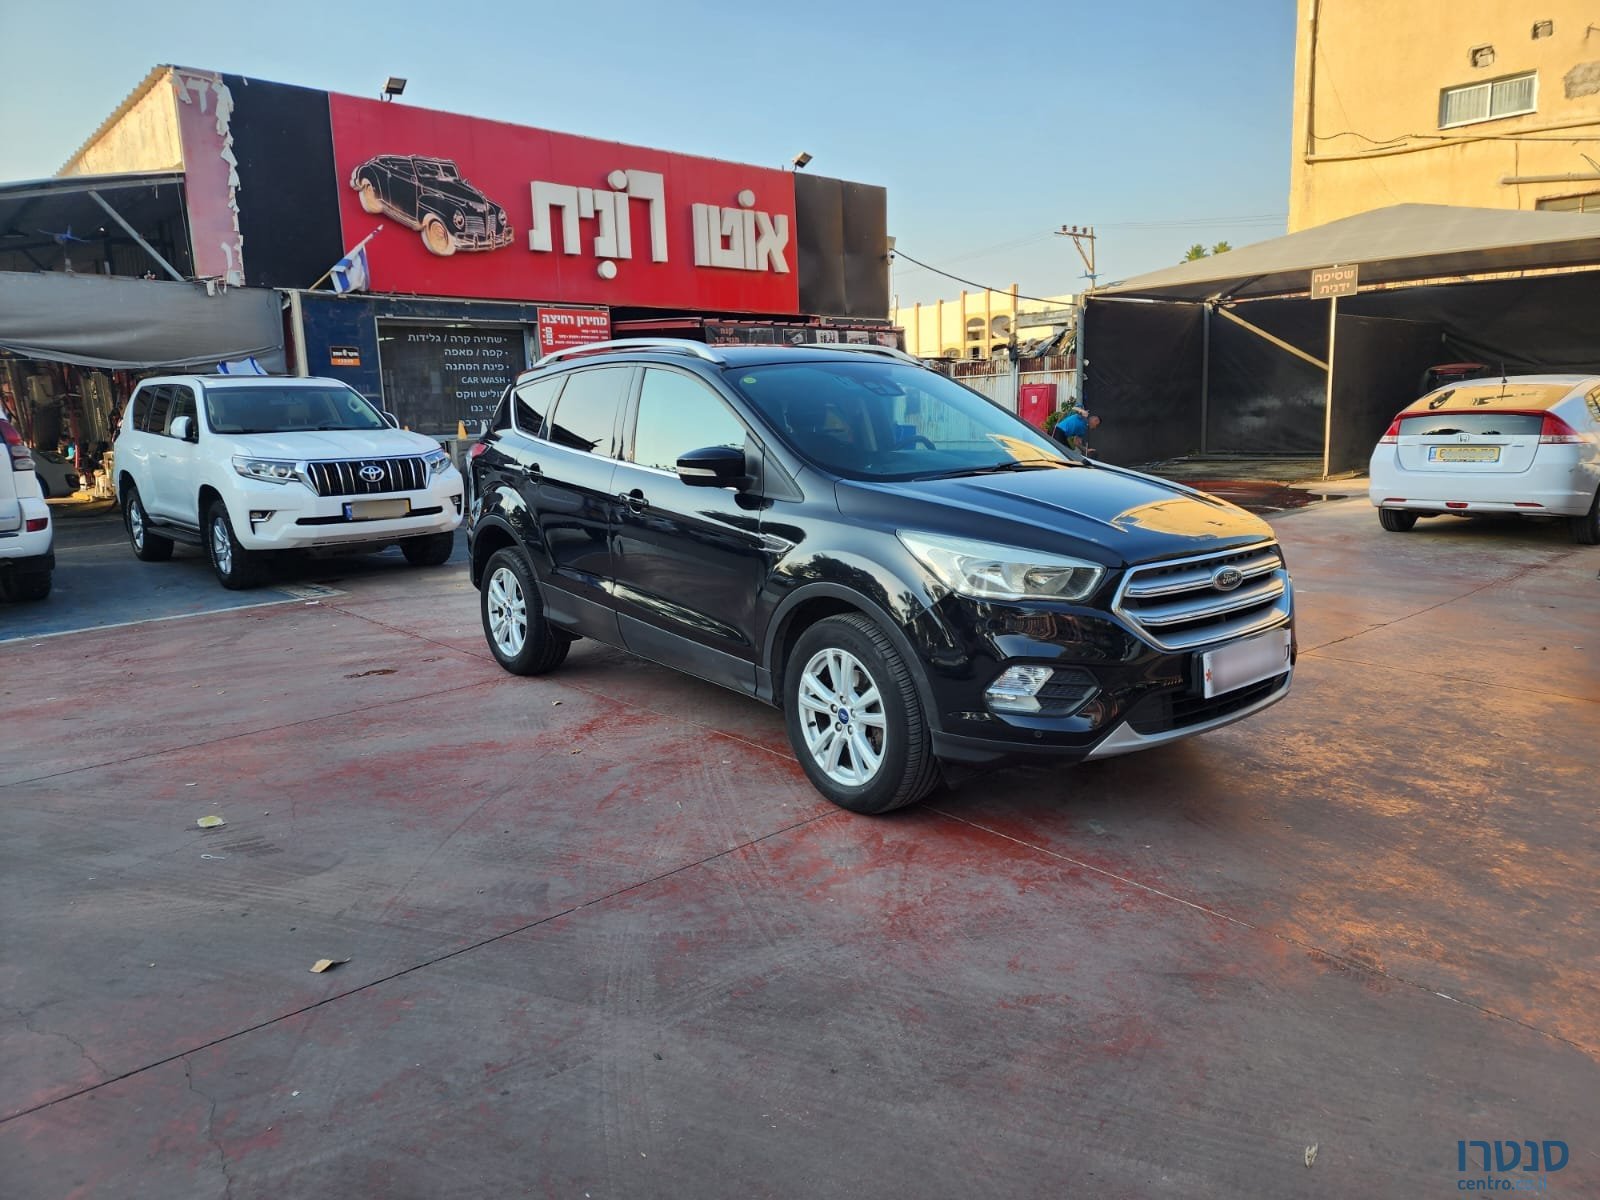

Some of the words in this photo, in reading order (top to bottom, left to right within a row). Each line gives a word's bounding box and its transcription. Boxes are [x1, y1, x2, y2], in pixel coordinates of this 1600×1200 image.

[541, 313, 575, 324] רחיצה
[576, 315, 608, 327] מחירון
[407, 333, 441, 343] גלידות
[450, 335, 471, 345] קרה
[474, 335, 503, 344] שתייה
[444, 348, 474, 357] מאפה
[482, 349, 503, 359] קפה
[445, 363, 480, 371] המתנה
[482, 363, 505, 371] פינת
[461, 376, 479, 384] CAR
[455, 391, 477, 400] ווקס
